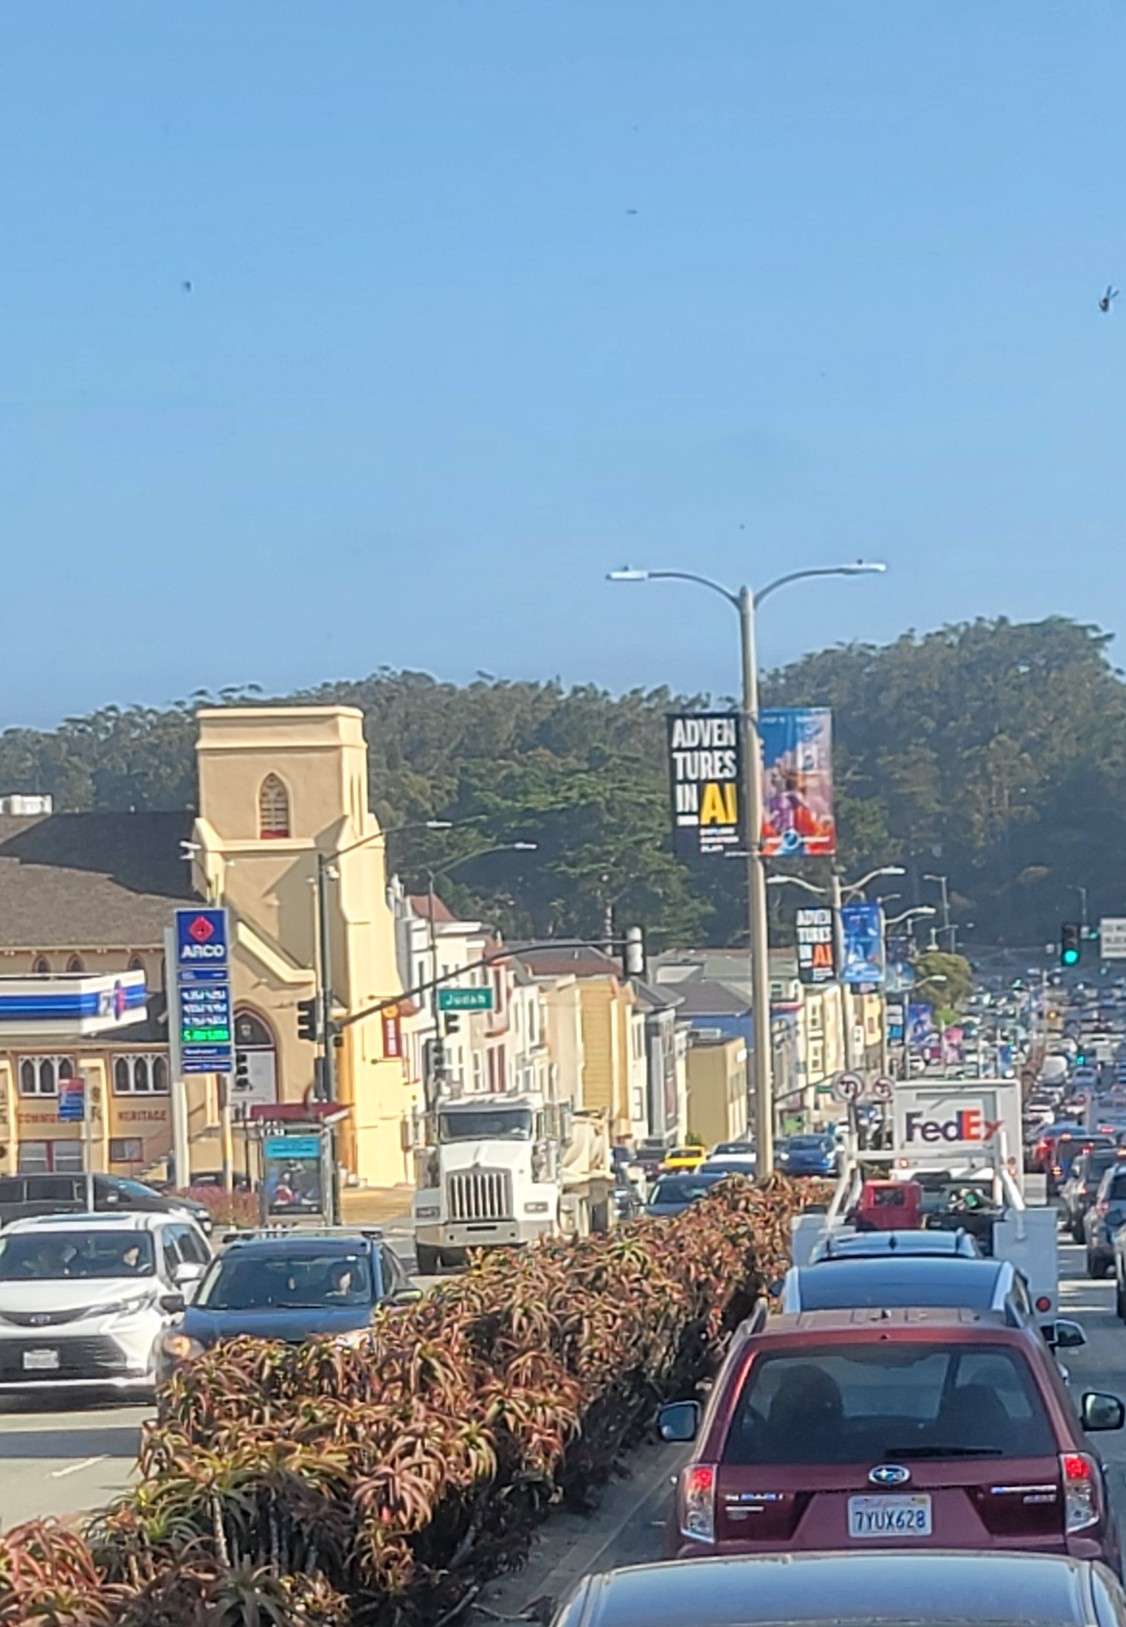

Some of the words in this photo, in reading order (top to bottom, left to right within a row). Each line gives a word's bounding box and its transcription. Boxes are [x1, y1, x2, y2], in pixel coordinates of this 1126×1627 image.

[672, 718, 736, 748] ADVEN
[672, 751, 737, 780] TURES
[676, 783, 698, 813] IN
[700, 782, 737, 825] AI
[181, 944, 225, 959] ARCO
[813, 944, 833, 968] AI
[445, 995, 487, 1006] Judah
[905, 1109, 1003, 1142] FedEx
[854, 1510, 926, 1530] 7YUX628
